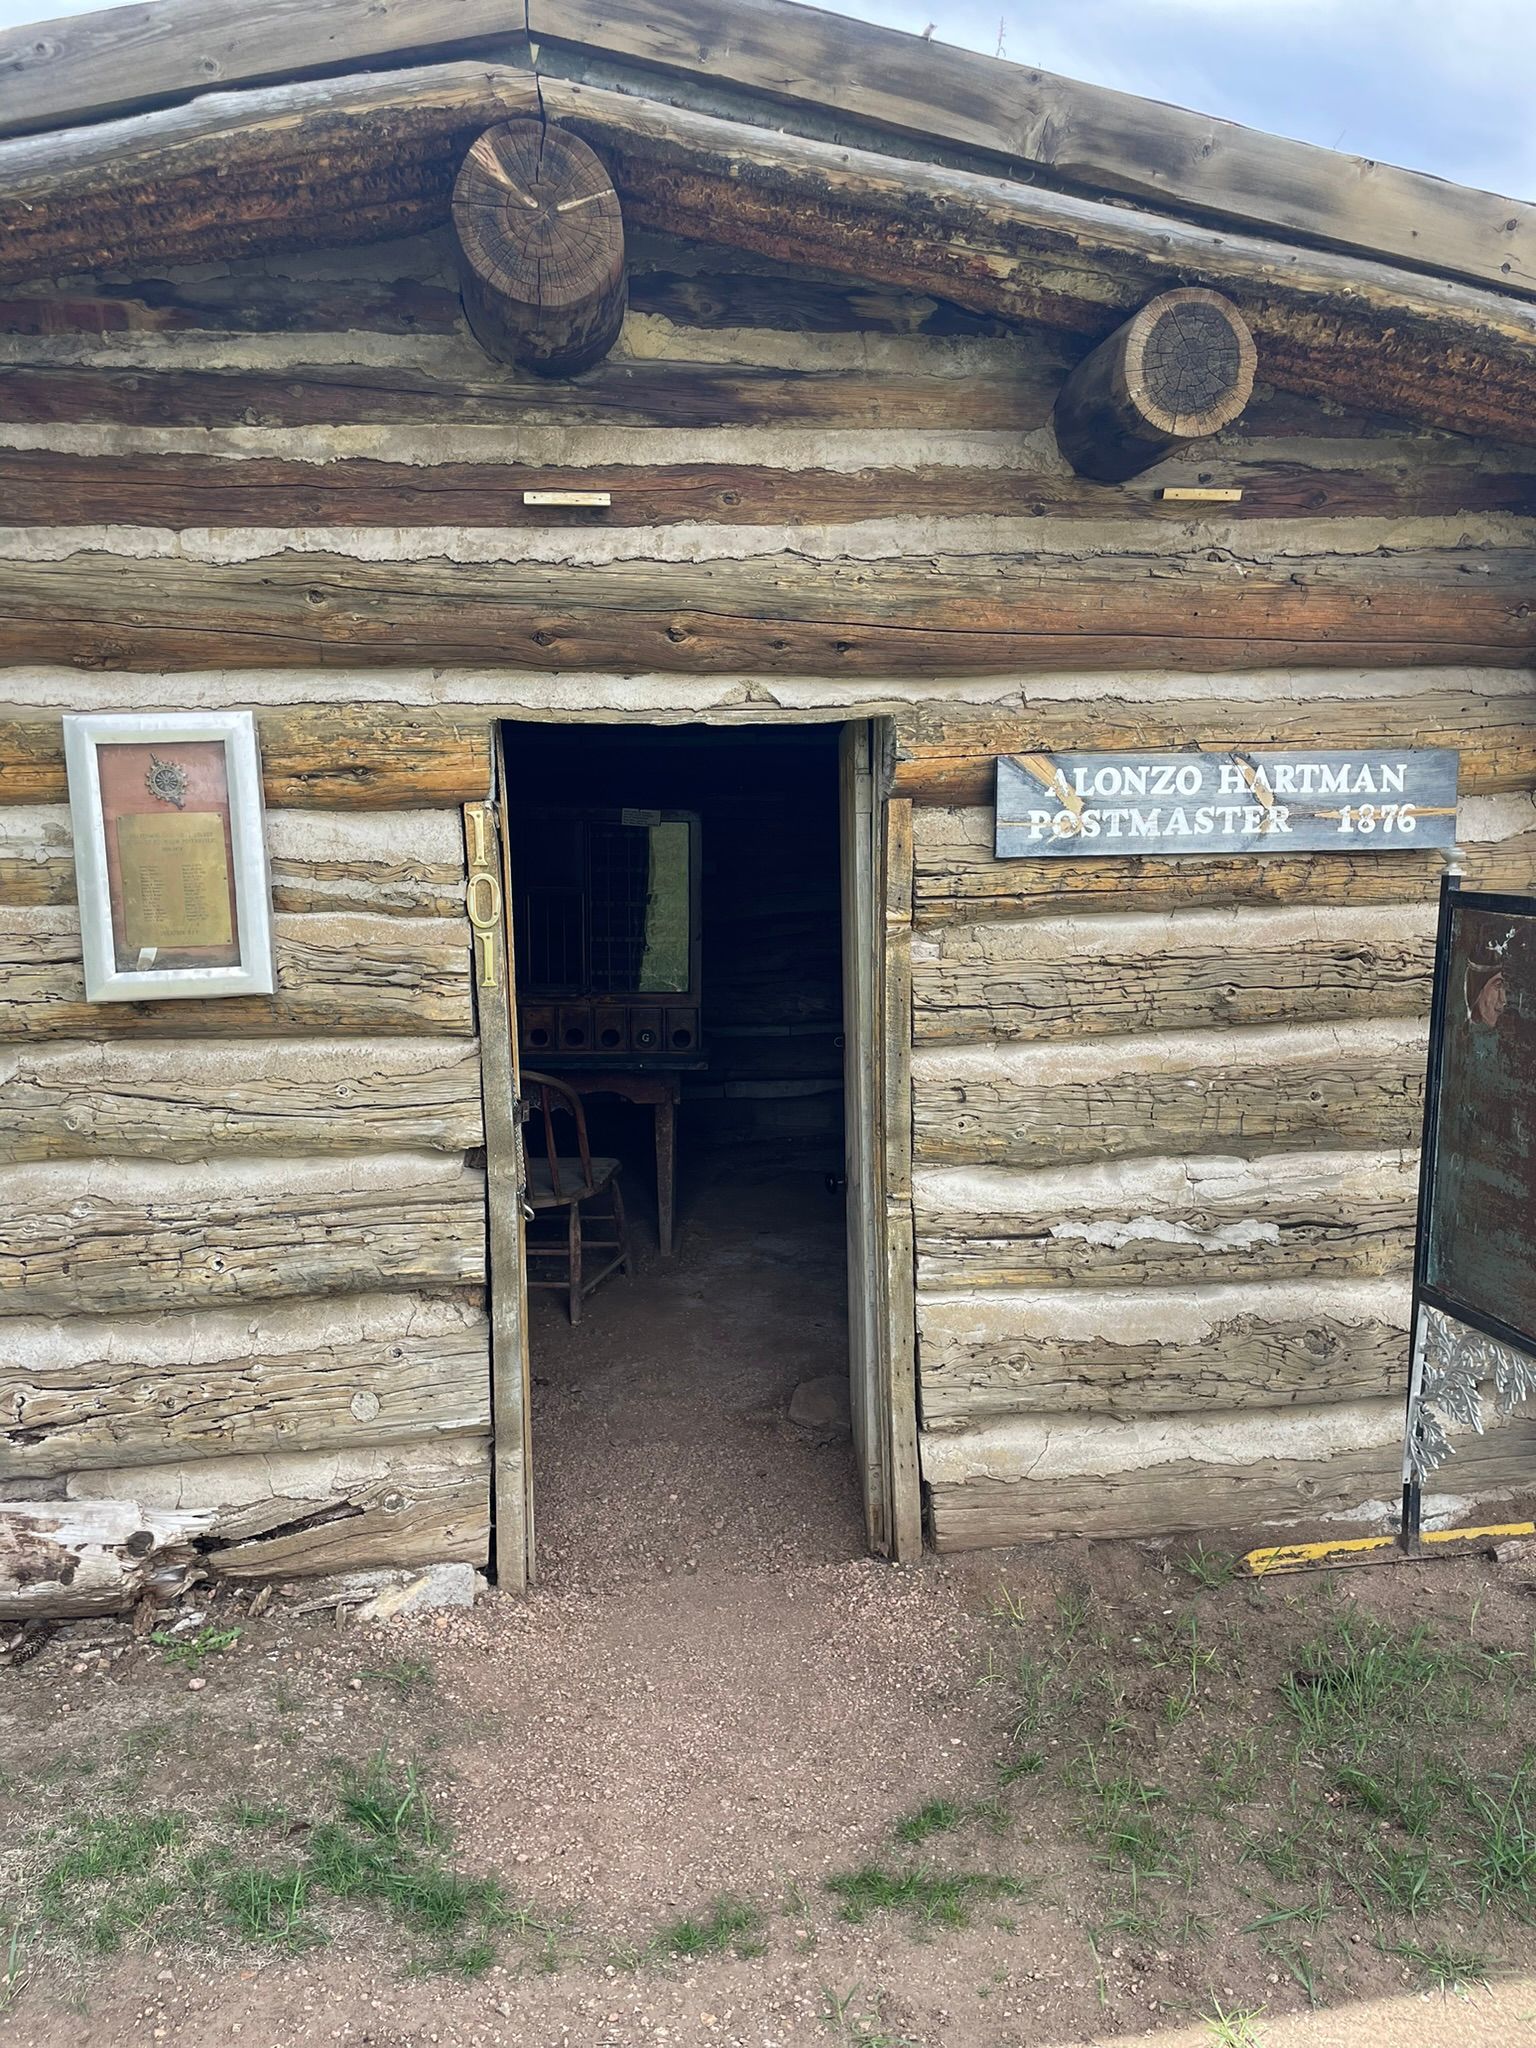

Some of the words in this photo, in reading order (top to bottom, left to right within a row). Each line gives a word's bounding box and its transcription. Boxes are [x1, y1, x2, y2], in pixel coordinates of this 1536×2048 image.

[1044, 764, 1202, 796] ALONZO
[1217, 763, 1408, 794] HARTMAN
[1027, 805, 1294, 839] POSTMASTER
[1337, 803, 1416, 834] 1876
